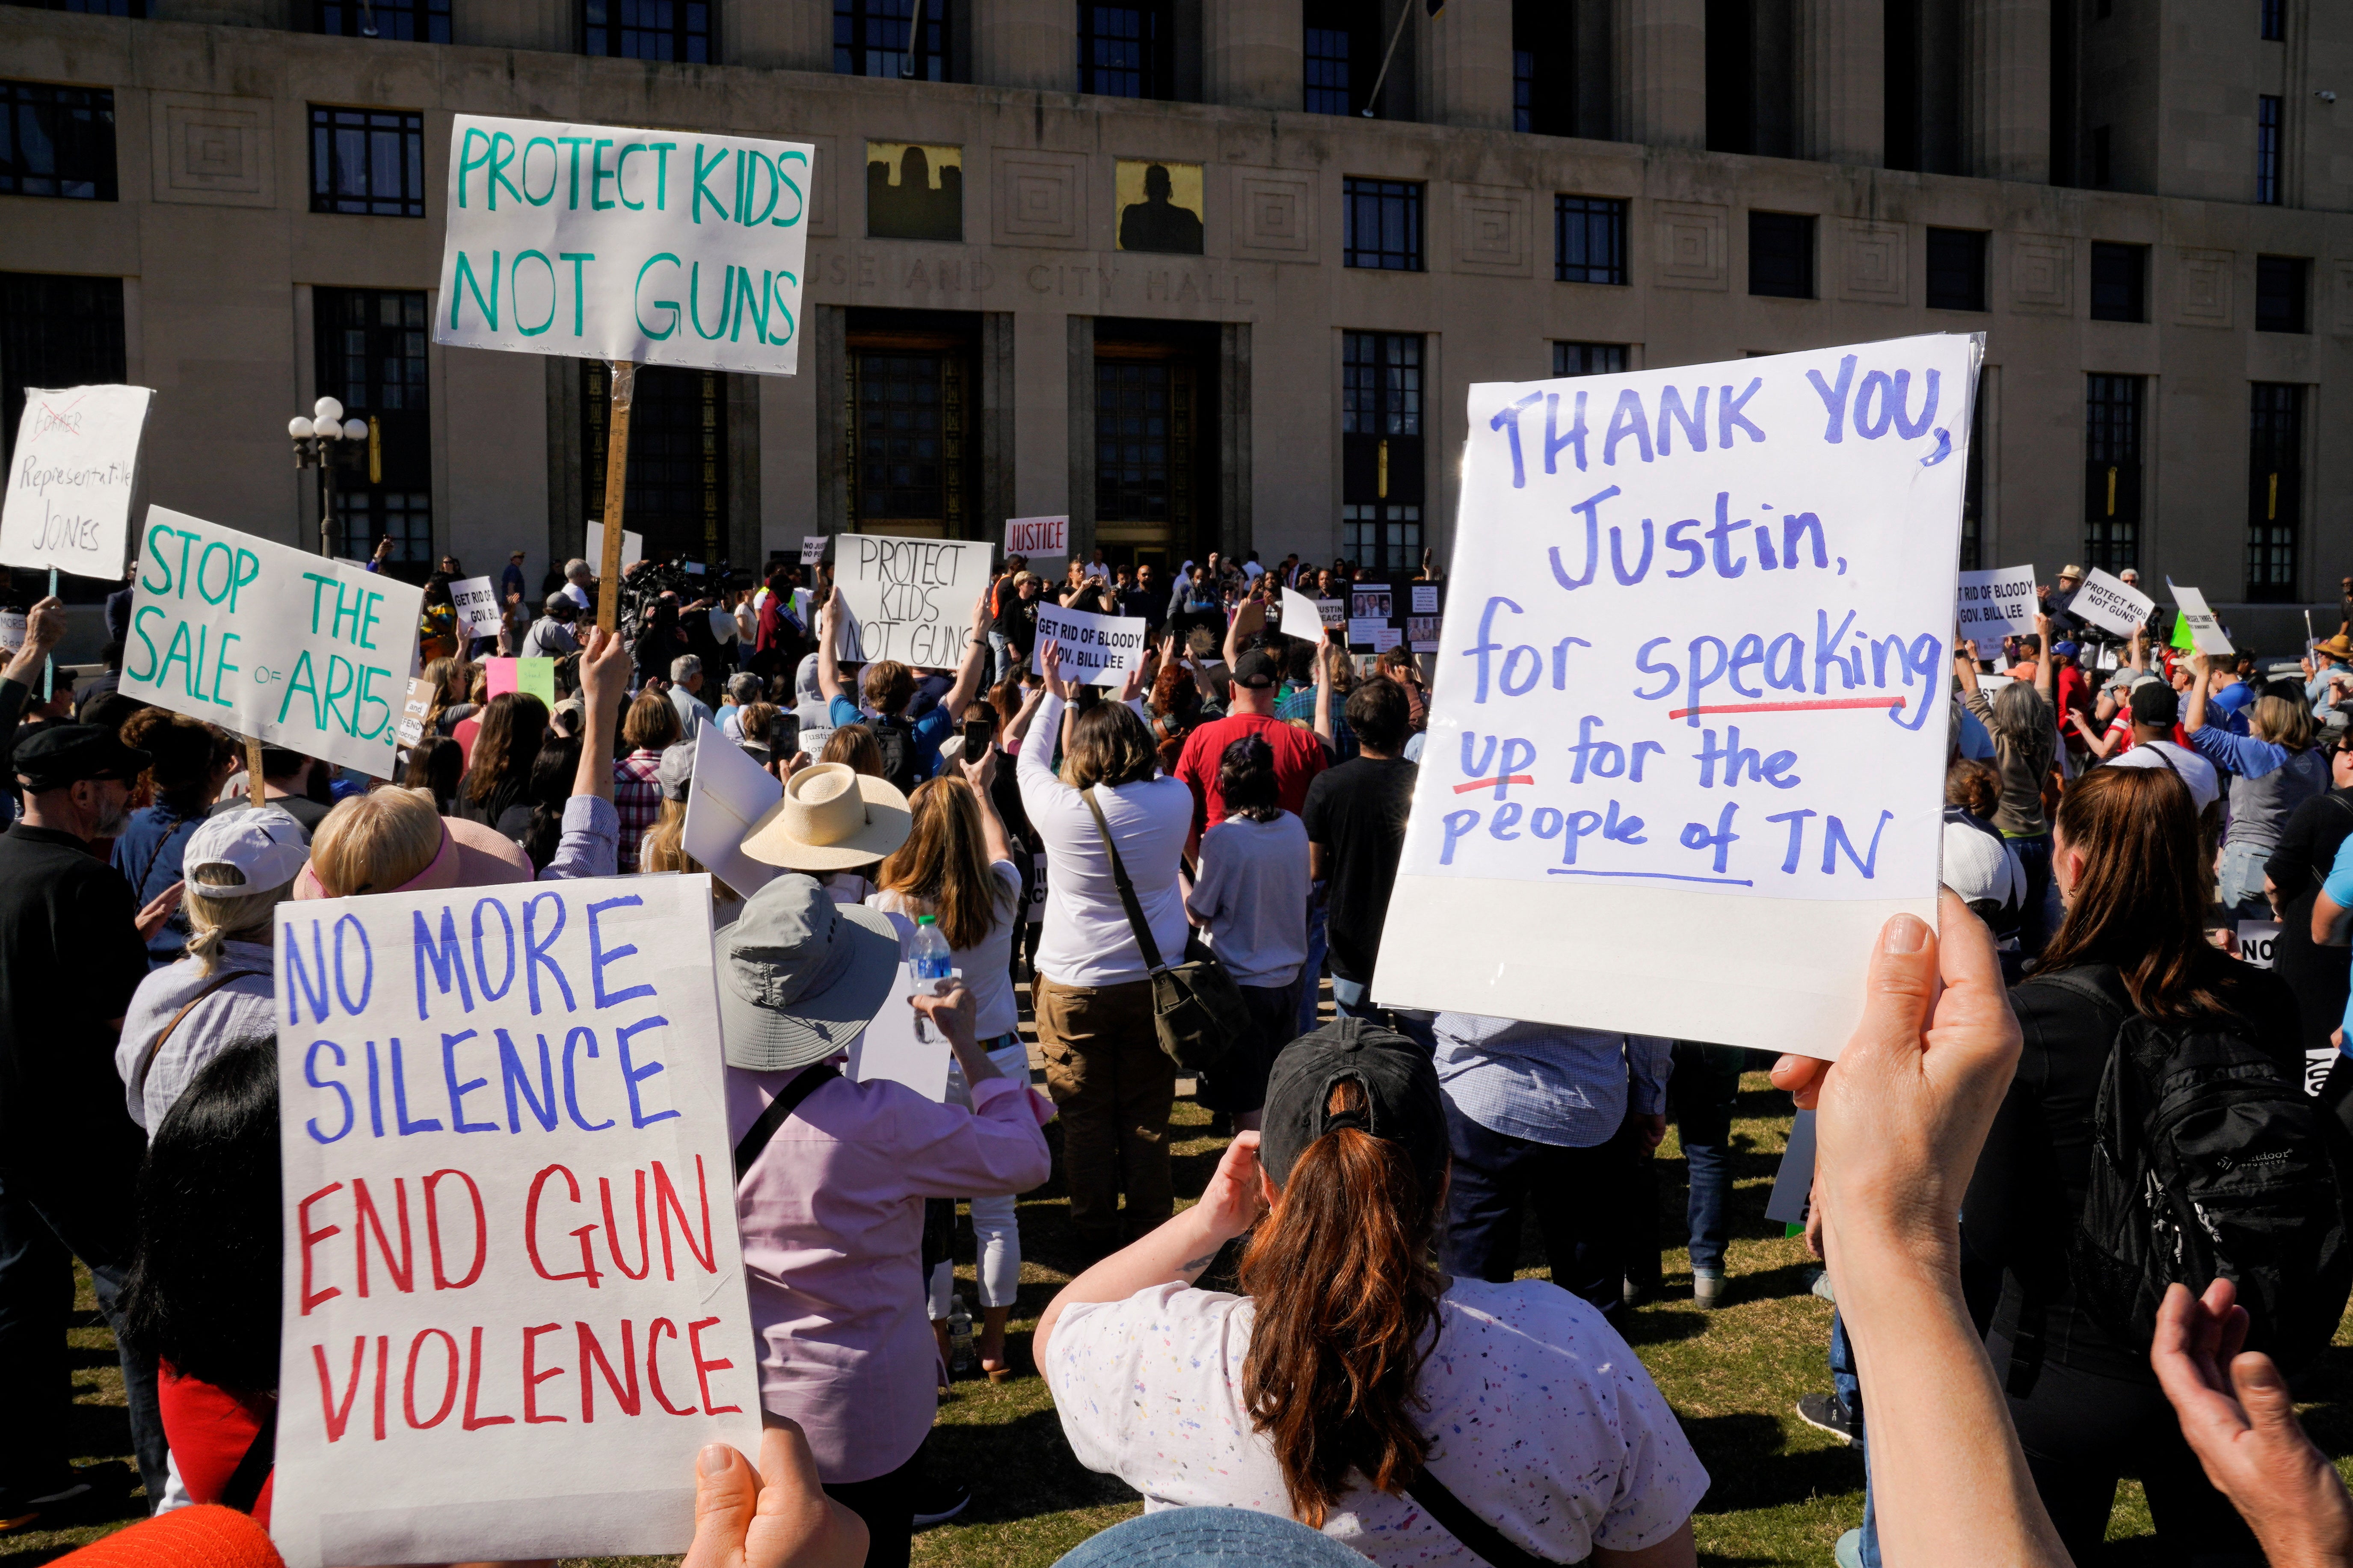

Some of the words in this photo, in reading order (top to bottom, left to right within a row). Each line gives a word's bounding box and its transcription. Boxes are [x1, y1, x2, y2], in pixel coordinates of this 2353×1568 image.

[459, 128, 676, 211] PROTECT
[692, 143, 807, 227] KIDS
[451, 249, 595, 336] NOT
[635, 253, 797, 346] GUNS
[906, 259, 995, 292] AND
[1027, 264, 1120, 298] CITY
[1147, 270, 1253, 305] HALL
[1491, 378, 1765, 488] THANK
[1807, 355, 1951, 467] YOU,
[33, 499, 99, 550] JONES
[1008, 522, 1064, 552] JUSTICE
[1549, 485, 1846, 590] Justin,
[860, 538, 966, 586] PROTECT
[142, 525, 259, 613] STOP
[303, 572, 383, 650] THE
[455, 593, 470, 606] GET
[471, 591, 484, 604] RID
[880, 581, 939, 622] KIDS
[1965, 586, 1979, 601] RID
[1981, 585, 1991, 599] OF
[1994, 580, 2033, 599] BLOODY
[2084, 580, 2127, 606] PROTECT
[2127, 603, 2147, 619] KIDS
[2088, 594, 2108, 608] NOT
[2109, 605, 2135, 623] GUNS
[0, 617, 25, 629] MORE
[471, 609, 489, 623] GOV.
[1039, 618, 1058, 636] GET
[1061, 623, 1078, 641] RID
[1081, 628, 1095, 644] OF
[1097, 631, 1142, 648] BLOODY
[1961, 608, 1982, 623] GOV.
[1983, 606, 2004, 621] BILL
[2005, 604, 2023, 618] LEE
[127, 605, 240, 708] SALE
[255, 666, 282, 684] OF
[845, 619, 900, 661] NOT
[1058, 646, 1073, 664] OV.
[1077, 651, 1100, 668] BILL
[1104, 654, 1124, 669] LEE
[1463, 597, 1591, 703] for
[1634, 609, 1941, 731] speaking
[409, 703, 422, 713] and
[1462, 732, 1535, 801] up
[1569, 716, 1665, 784] for
[1692, 725, 1801, 789] the
[1440, 800, 1647, 864] people
[1680, 802, 1740, 873] of
[1766, 809, 1894, 879] TN
[285, 914, 373, 1026] NO
[413, 892, 657, 1021] MORE
[2242, 940, 2275, 961] NO
[305, 1015, 681, 1144] SILENCE
[2242, 1159, 2286, 1167] PRODUCTS
[298, 1169, 486, 1316] END
[525, 1154, 717, 1288] GUN
[313, 1317, 742, 1442] VIOLENCE
